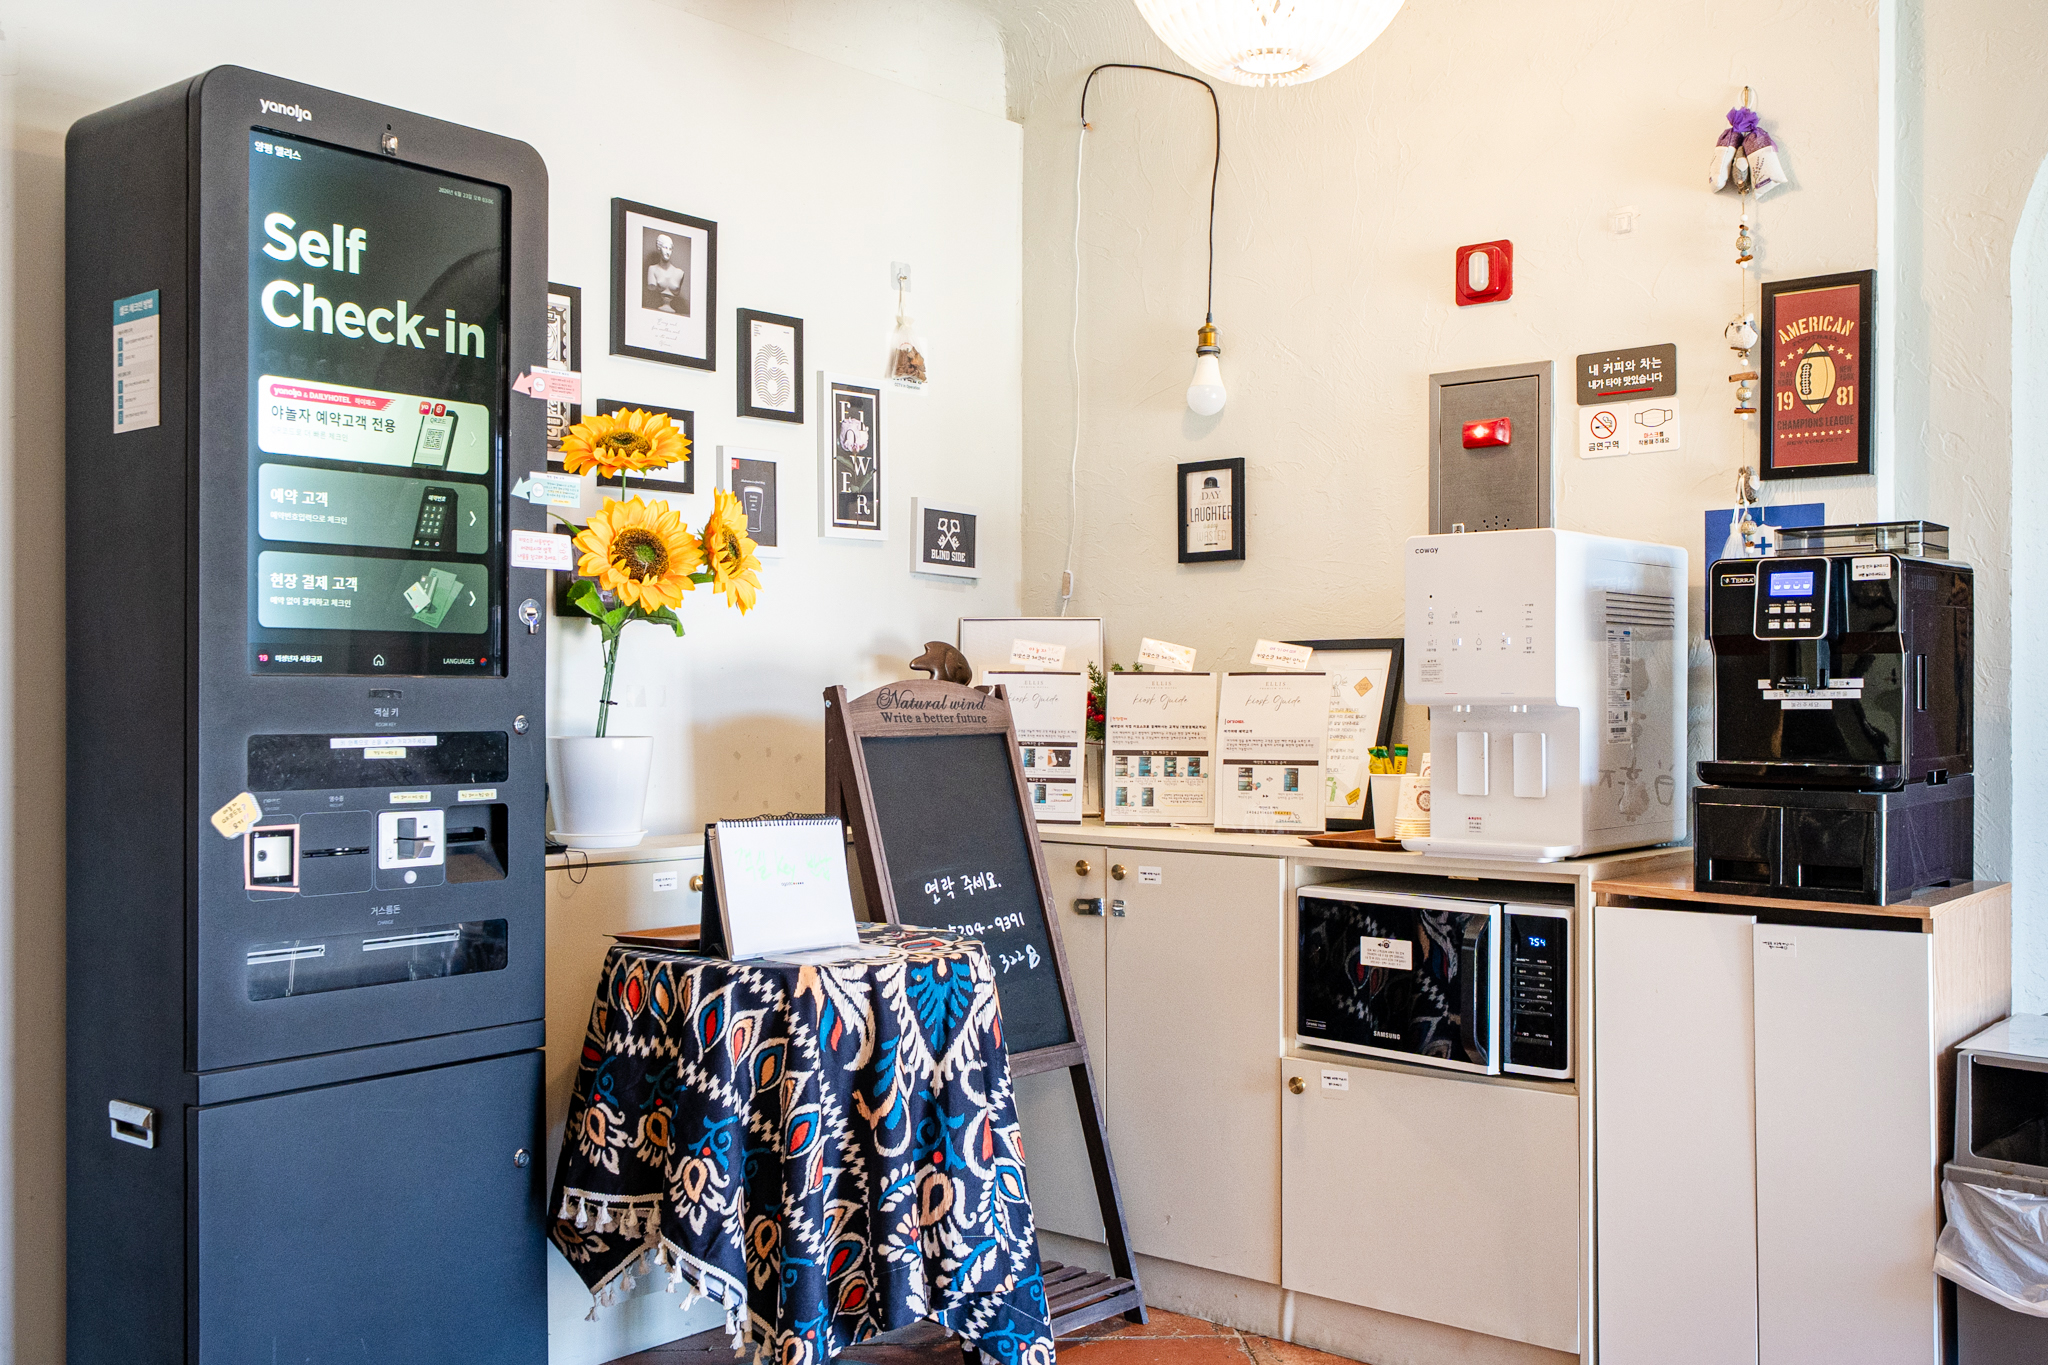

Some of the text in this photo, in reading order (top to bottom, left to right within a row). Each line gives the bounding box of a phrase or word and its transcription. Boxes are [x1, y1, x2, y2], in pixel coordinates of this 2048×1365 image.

[262, 212, 367, 275] Self
[261, 279, 485, 359] Check-in
[1777, 315, 1855, 345] AMERICAN
[1792, 334, 1839, 347] FOOTBALL
[1588, 356, 1662, 376] 내 커피와 차는
[1840, 365, 1852, 373] NEW
[1588, 371, 1663, 390] 내가 타야 맛있습니다
[309, 391, 351, 404] DAILYHOTEL
[1776, 385, 1854, 412] 19 81
[271, 405, 396, 433] 야놀자 예약고객 전용
[1777, 414, 1854, 431] CHAMPIONS LEAGUE
[1588, 440, 1620, 452] 금연구역
[270, 488, 328, 507] 예약 고객
[1201, 490, 1221, 501] DAY
[327, 515, 347, 525] 체크인
[1197, 529, 1227, 542] WASTED
[931, 548, 966, 563] BLIND SIDE
[1415, 547, 1439, 555] coway
[270, 572, 358, 592] 현장 결제 고객
[331, 599, 351, 608] 체크인
[258, 654, 269, 662] 19
[876, 687, 987, 710] Natural wind
[374, 707, 399, 717] 객실 키
[880, 711, 988, 724] Write a better future
[924, 875, 955, 905] 연락
[371, 904, 401, 916] 거스름돈
[1373, 1030, 1401, 1040] SAMSUNG
